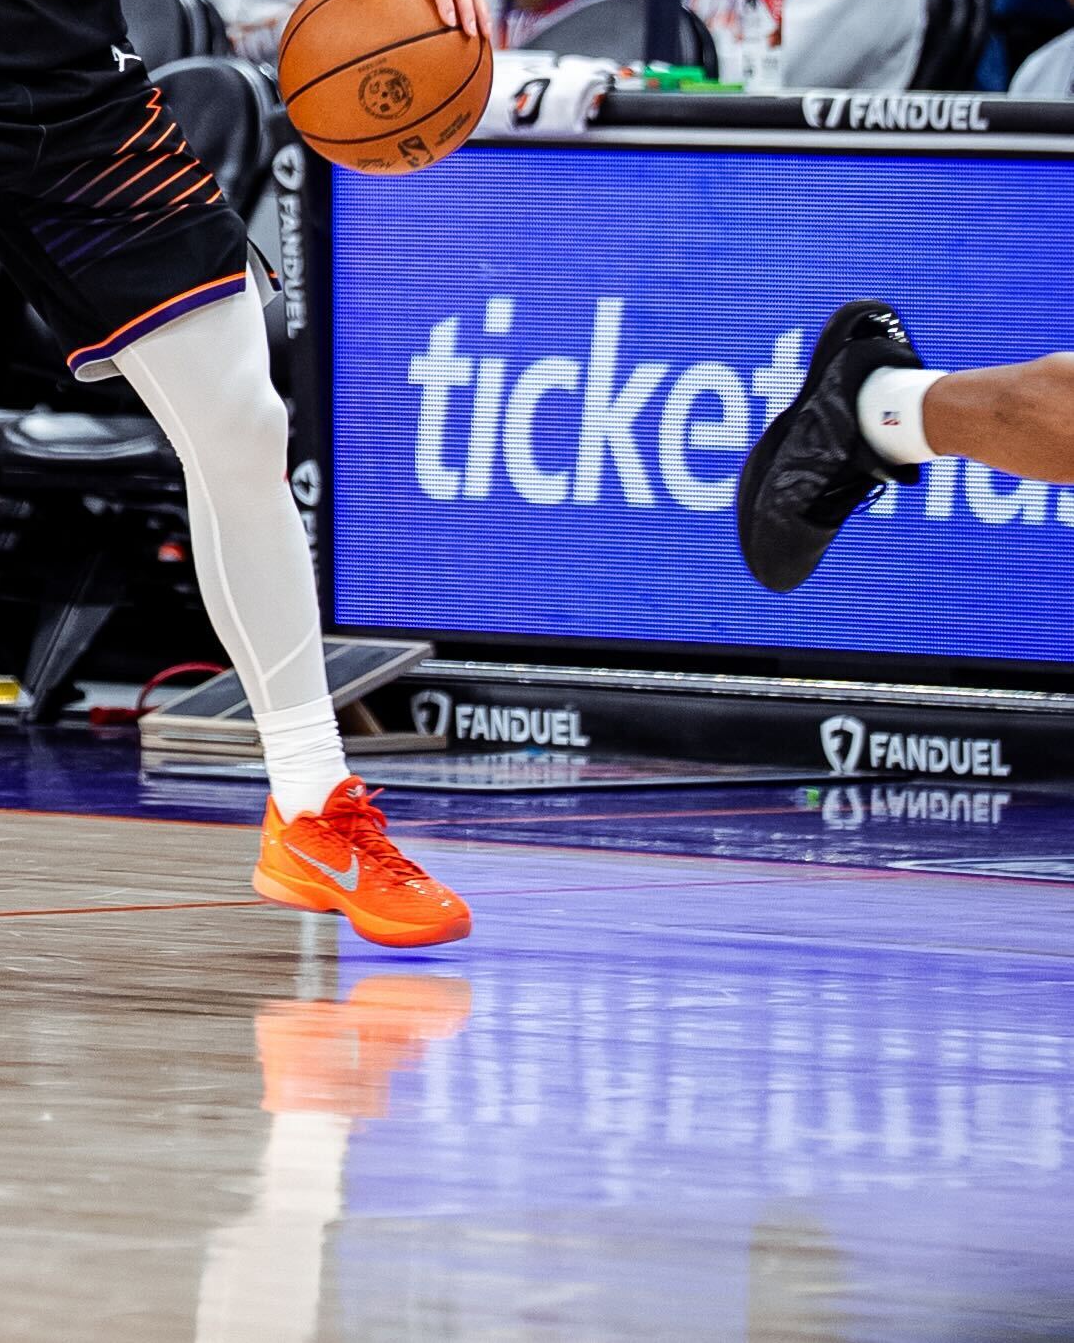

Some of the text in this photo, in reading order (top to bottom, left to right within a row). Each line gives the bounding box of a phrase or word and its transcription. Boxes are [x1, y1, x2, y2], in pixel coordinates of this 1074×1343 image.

[848, 95, 990, 131] FANDUEL
[278, 192, 308, 340] FANDUEL
[454, 703, 592, 748] FANDUEL
[869, 731, 1013, 777] FANDUEL
